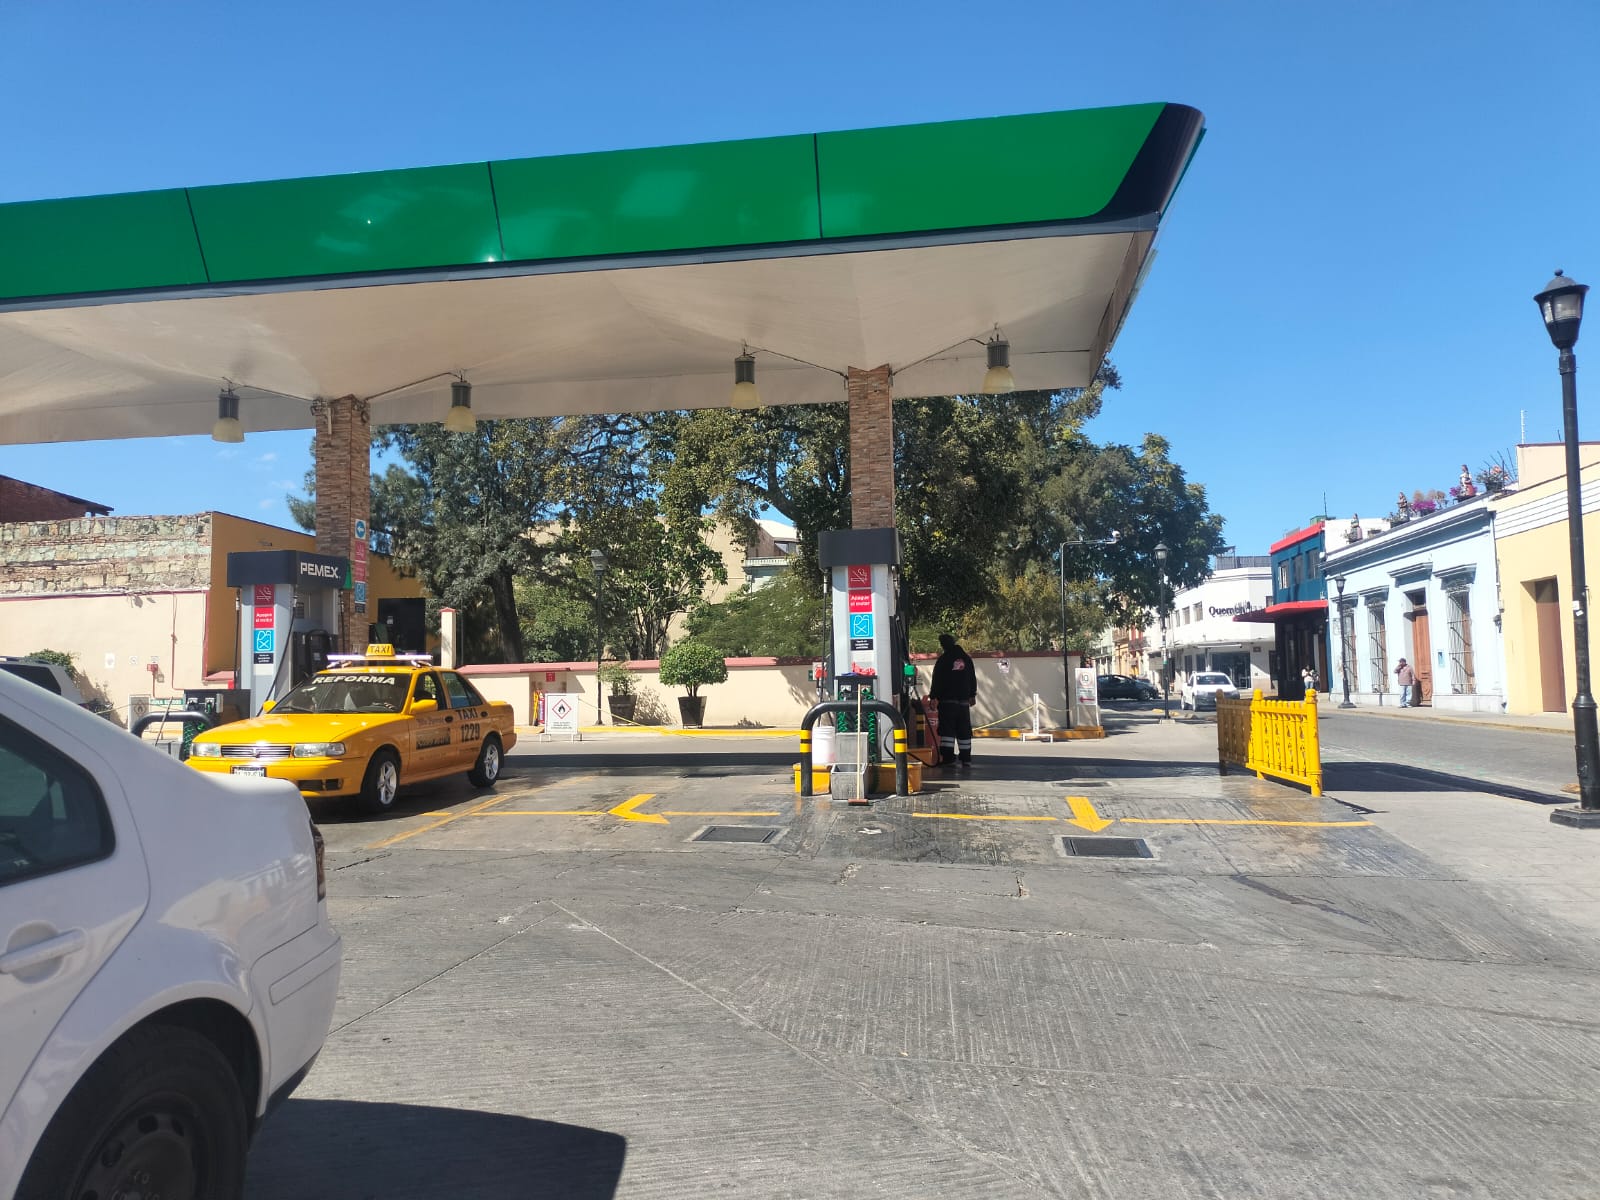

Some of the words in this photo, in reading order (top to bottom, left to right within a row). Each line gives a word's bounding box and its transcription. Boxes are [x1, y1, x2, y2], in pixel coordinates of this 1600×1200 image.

[300, 562, 339, 578] PEMEX
[370, 646, 390, 654] TAXI
[312, 675, 395, 685] REFORMA
[456, 708, 478, 720] TAXI
[461, 724, 480, 743] 1229
